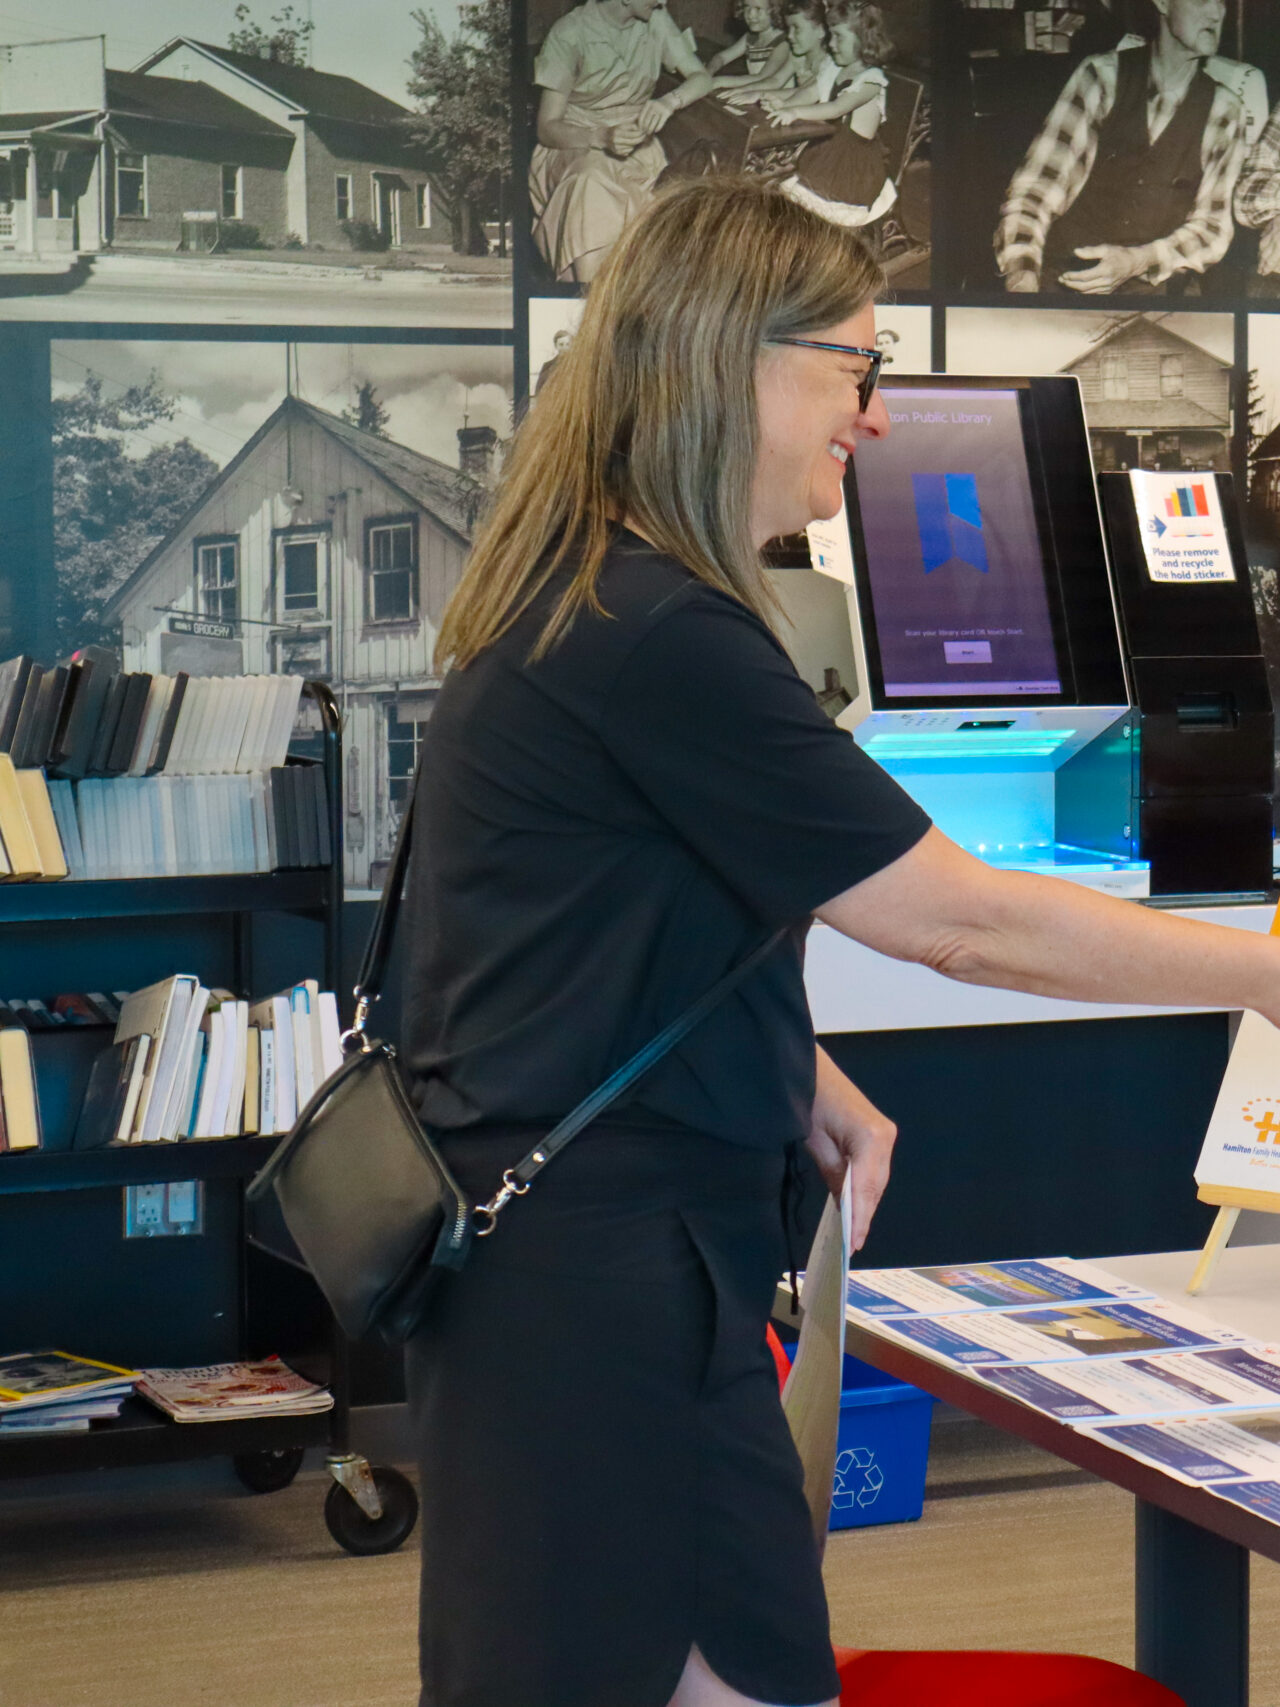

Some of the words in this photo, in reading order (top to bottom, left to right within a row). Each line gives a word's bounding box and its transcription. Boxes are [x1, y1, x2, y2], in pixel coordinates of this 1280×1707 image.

[912, 411, 948, 423] Public
[952, 412, 992, 426] Library
[1152, 547, 1181, 557] Please
[1183, 548, 1219, 556] remove
[1162, 559, 1178, 568] and
[1181, 558, 1214, 569] recycle
[1154, 570, 1168, 579] the
[1171, 571, 1191, 580] hold
[1193, 570, 1228, 580] sticker.
[193, 622, 230, 637] GROCERY
[1222, 1143, 1252, 1154] Hamilton
[1252, 1147, 1270, 1157] Family
